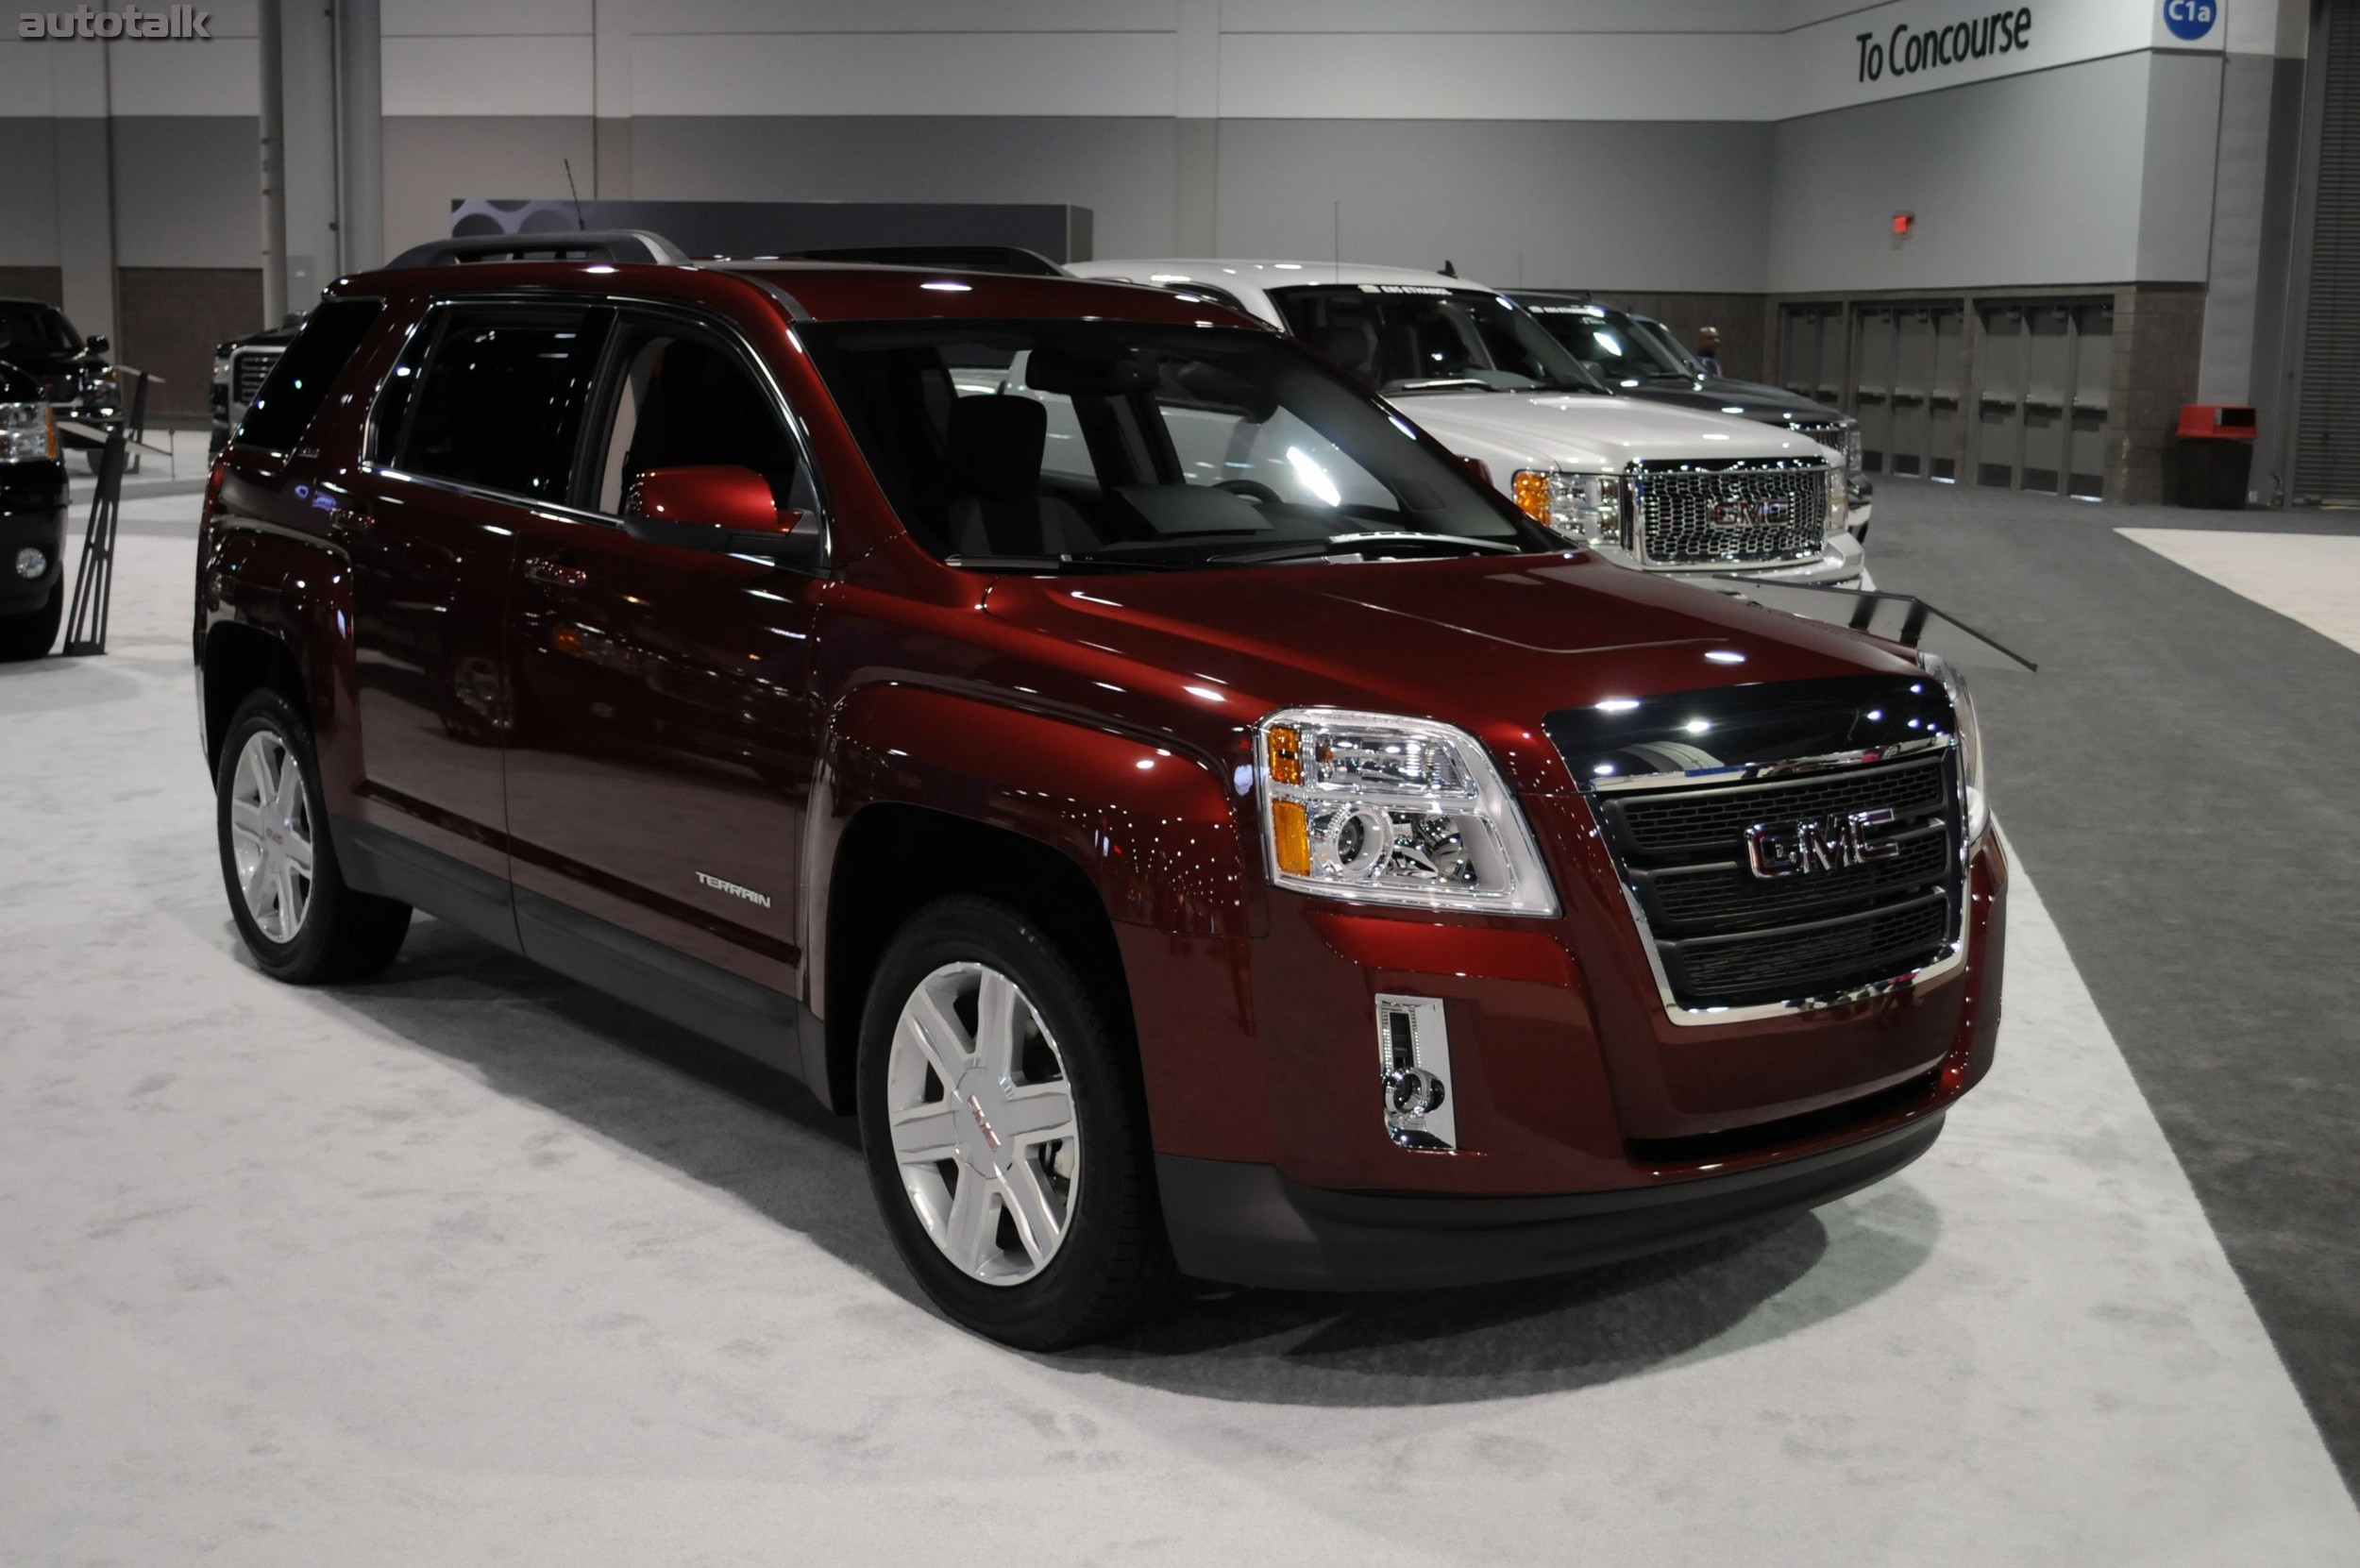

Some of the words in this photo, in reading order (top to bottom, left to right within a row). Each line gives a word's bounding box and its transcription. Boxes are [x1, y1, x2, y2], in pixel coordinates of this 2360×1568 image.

[2168, 0, 2211, 23] C1a
[1856, 33, 1883, 83] To
[1889, 7, 2031, 76] Concourse
[1708, 497, 1790, 527] GMC
[1745, 807, 1899, 878] GMC
[695, 870, 770, 908] TERRAIN
